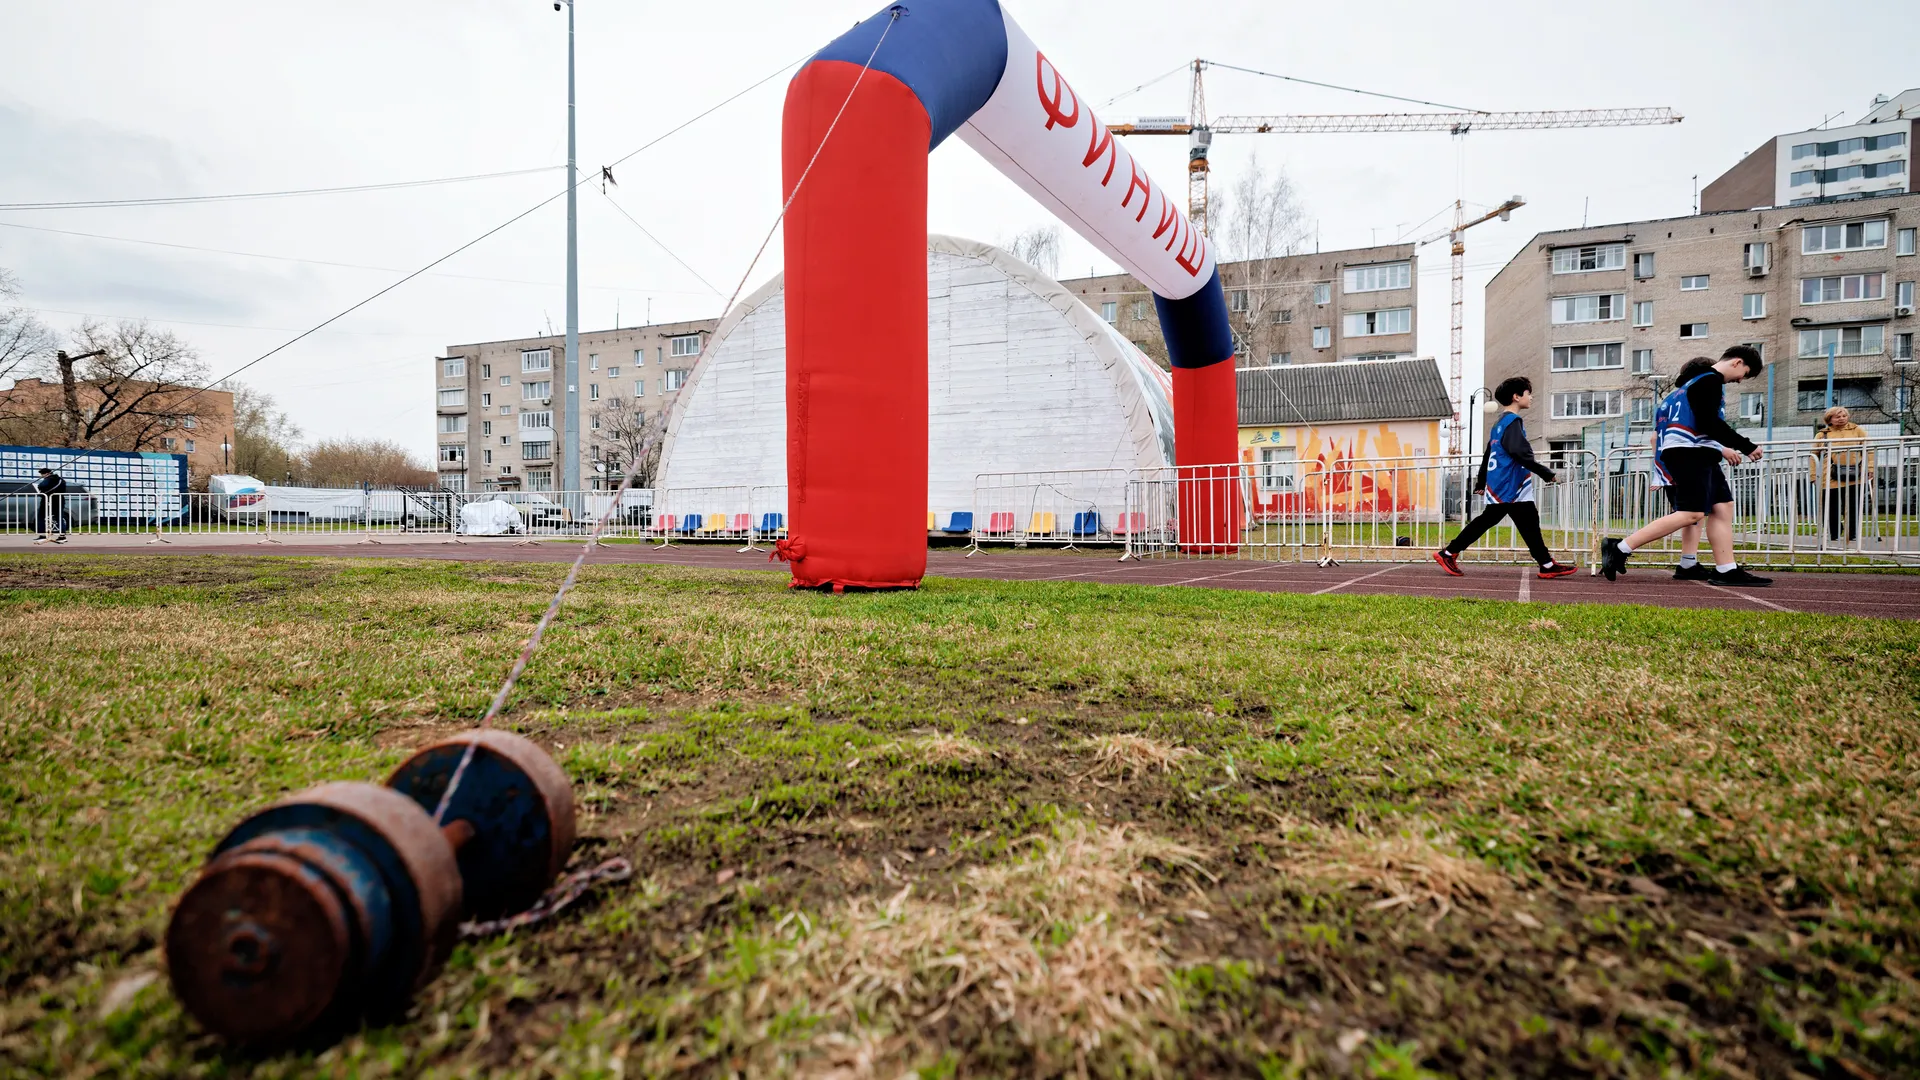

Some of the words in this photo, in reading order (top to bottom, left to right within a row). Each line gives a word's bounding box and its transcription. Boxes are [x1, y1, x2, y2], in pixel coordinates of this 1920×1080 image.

[1036, 50, 1206, 278] ФИНИШ
[1668, 401, 1681, 422] 12
[1487, 451, 1498, 471] 6
